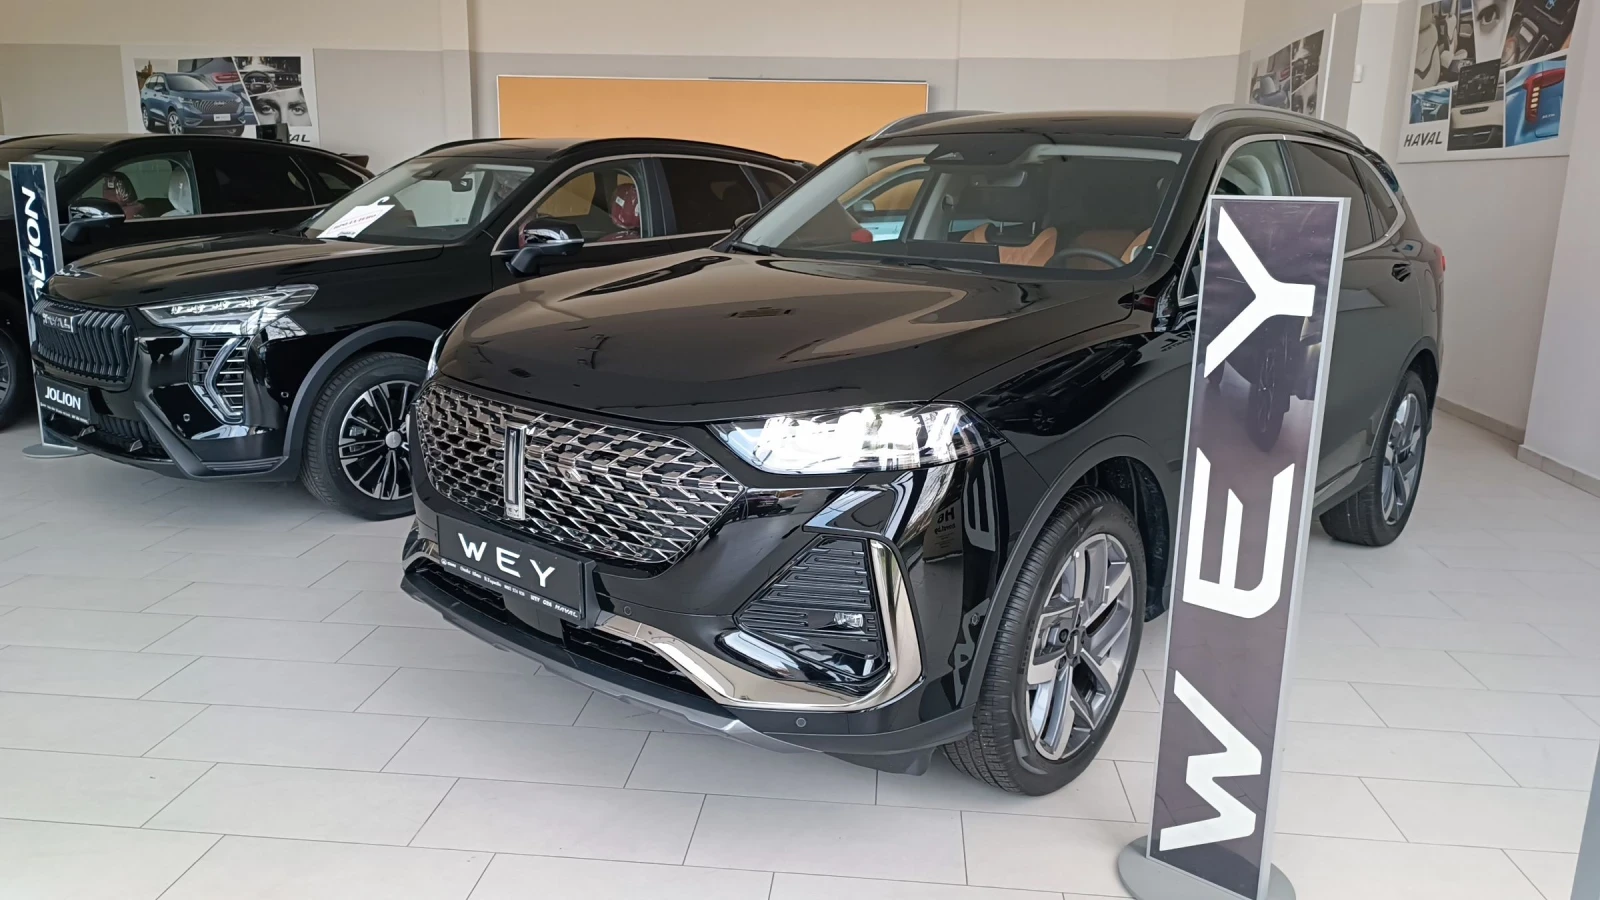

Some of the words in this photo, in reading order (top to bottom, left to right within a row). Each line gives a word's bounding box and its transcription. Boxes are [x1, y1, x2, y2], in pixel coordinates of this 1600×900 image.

[1403, 131, 1443, 147] HAVAL
[44, 386, 82, 411] JOLION
[1160, 206, 1316, 852] WEY
[457, 532, 556, 588] WEY
